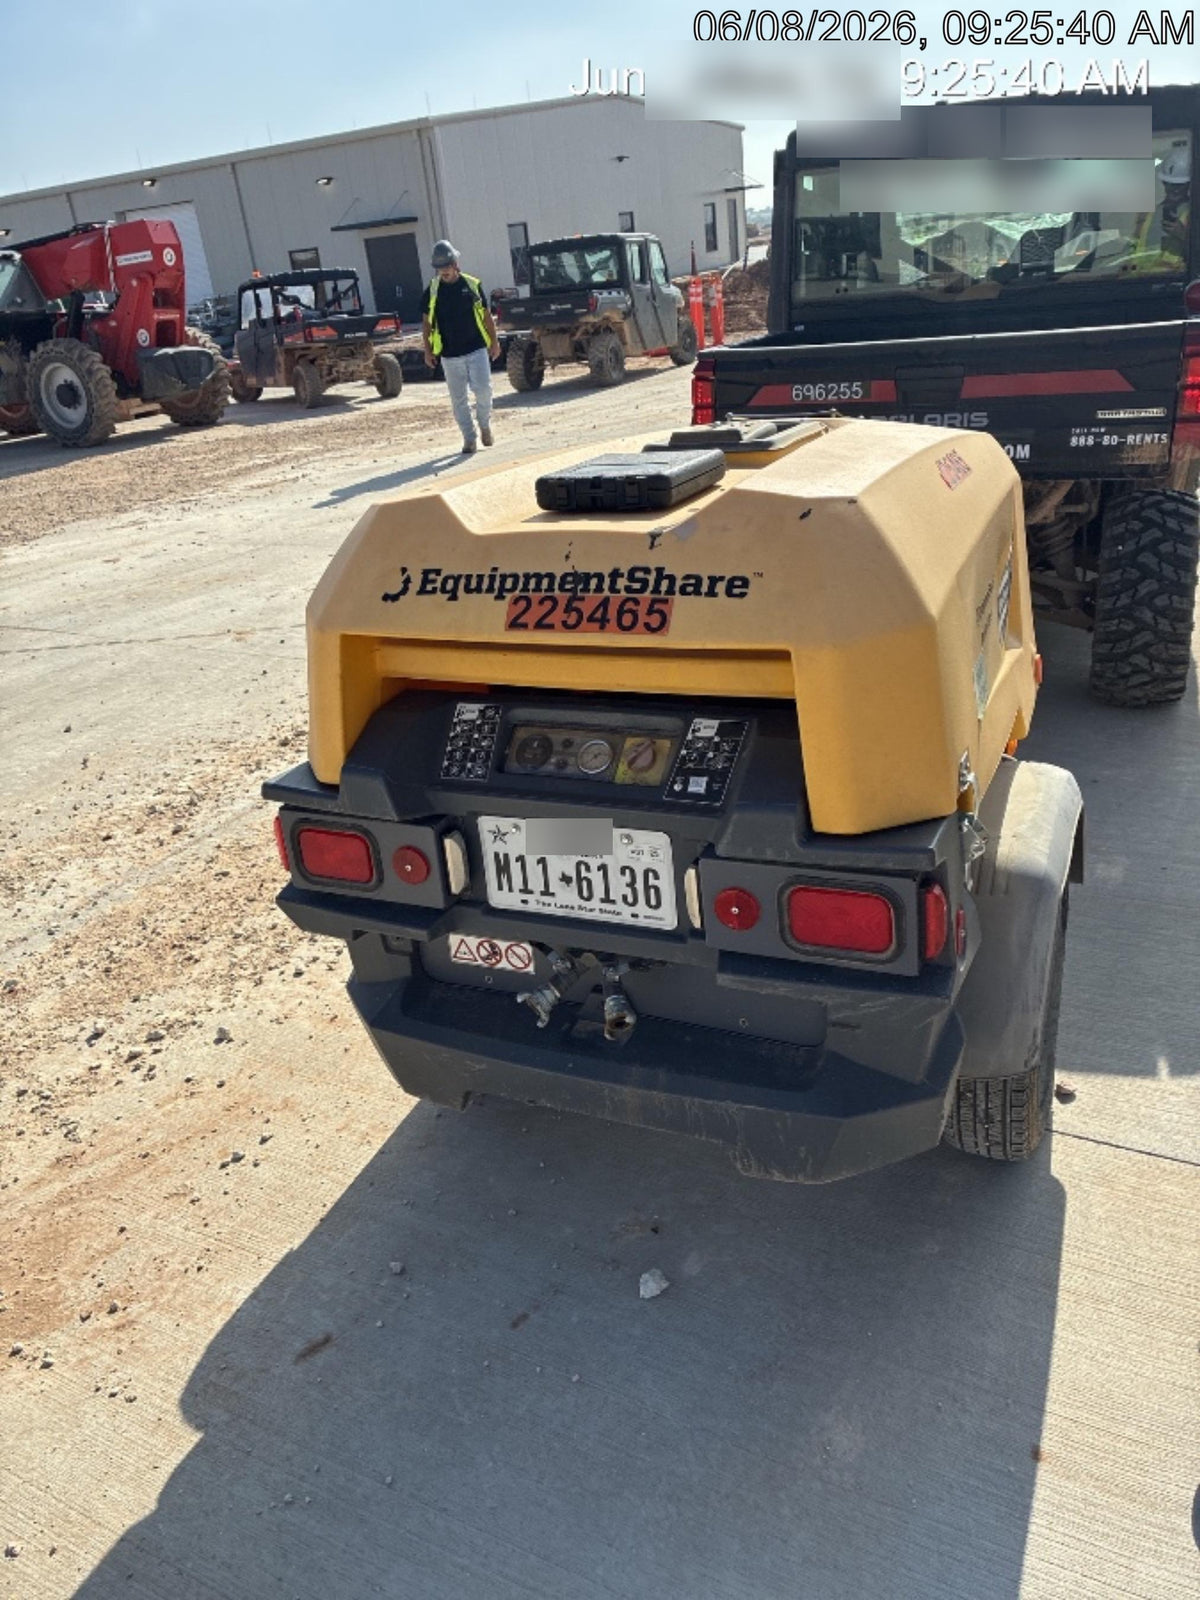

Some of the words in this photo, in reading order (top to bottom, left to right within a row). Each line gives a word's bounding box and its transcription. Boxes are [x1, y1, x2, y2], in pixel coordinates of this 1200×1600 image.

[791, 382, 864, 402] 696255
[1003, 444, 1031, 460] OM
[1070, 433, 1168, 447] 888-80-RENTS
[415, 565, 751, 602] EquipmentShare
[507, 596, 669, 634] 225465
[575, 860, 663, 911] 6136
